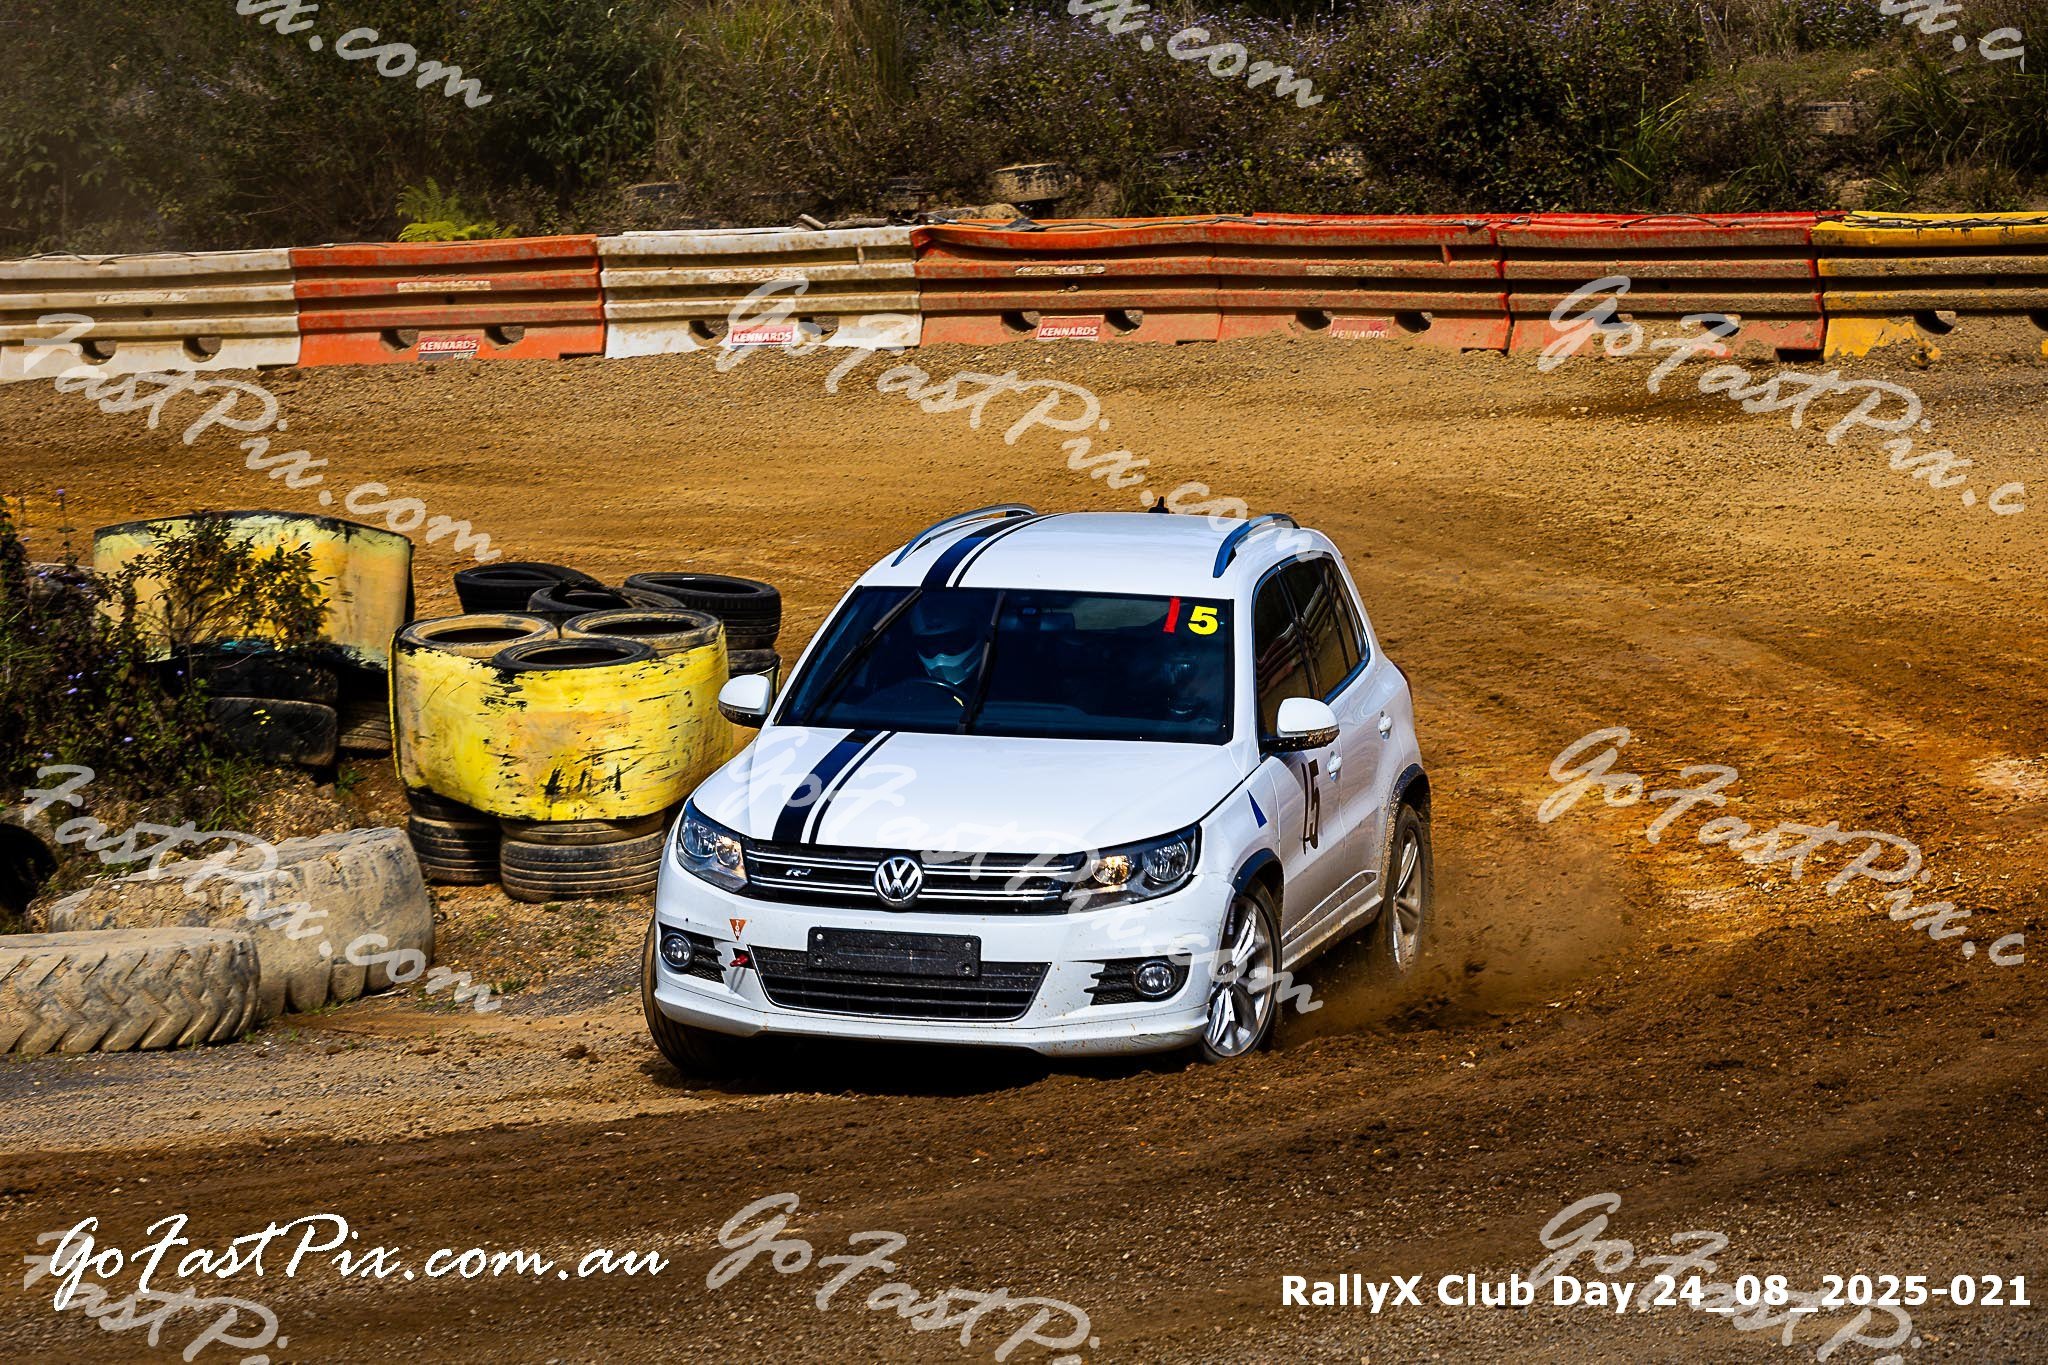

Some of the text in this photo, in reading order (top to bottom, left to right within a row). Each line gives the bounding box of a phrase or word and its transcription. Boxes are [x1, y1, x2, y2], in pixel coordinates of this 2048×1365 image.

[1040, 326, 1098, 337] KENNARDS
[732, 332, 791, 343] KENNARDS
[420, 340, 477, 351] KENNARDS
